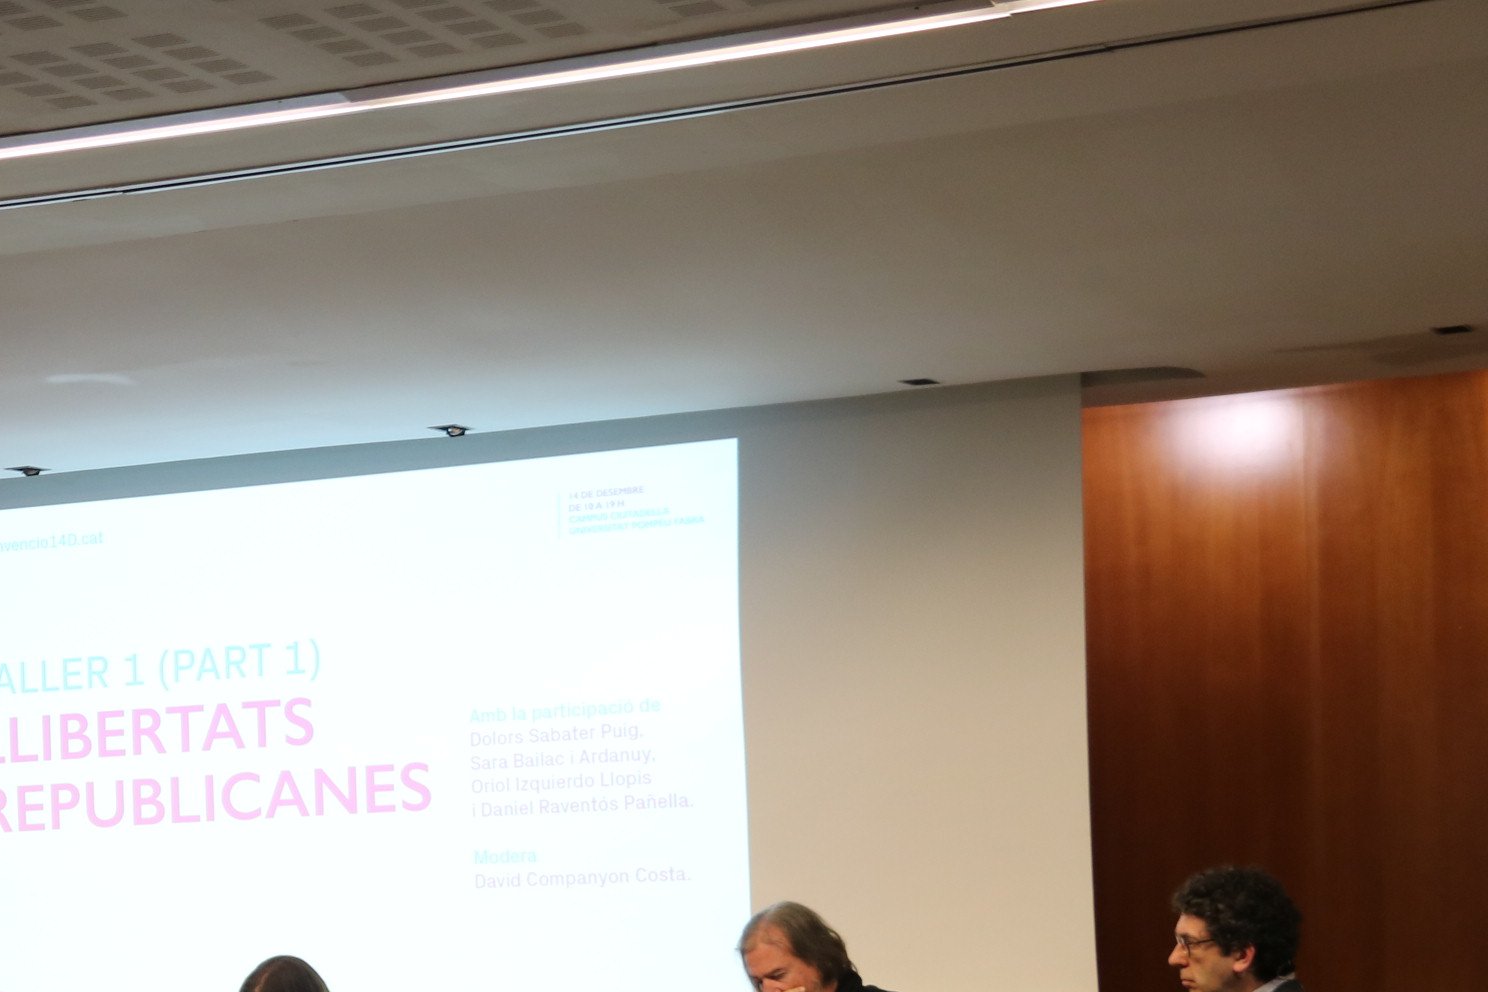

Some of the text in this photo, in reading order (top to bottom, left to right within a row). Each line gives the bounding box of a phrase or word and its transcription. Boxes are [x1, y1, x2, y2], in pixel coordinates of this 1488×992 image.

[581, 490, 594, 499] DE
[596, 485, 645, 498] DESEMBRE
[568, 503, 583, 512] DE
[124, 653, 145, 686] 1
[159, 643, 273, 692] (PART
[287, 637, 321, 681] 1)
[470, 706, 508, 723] Amb
[512, 703, 527, 721] la
[639, 697, 662, 714] de
[470, 730, 524, 748] Dolors
[529, 726, 596, 744] Sabater
[471, 756, 508, 771] Sara
[513, 752, 565, 769] Bailac
[471, 769, 653, 794] Oriol Izquierdo Llopis
[481, 800, 534, 818] Daniel
[539, 796, 619, 815] Raventós
[624, 792, 695, 810] Pañella.
[473, 848, 538, 866] Modera
[475, 866, 693, 890] David Companyon Costa.
